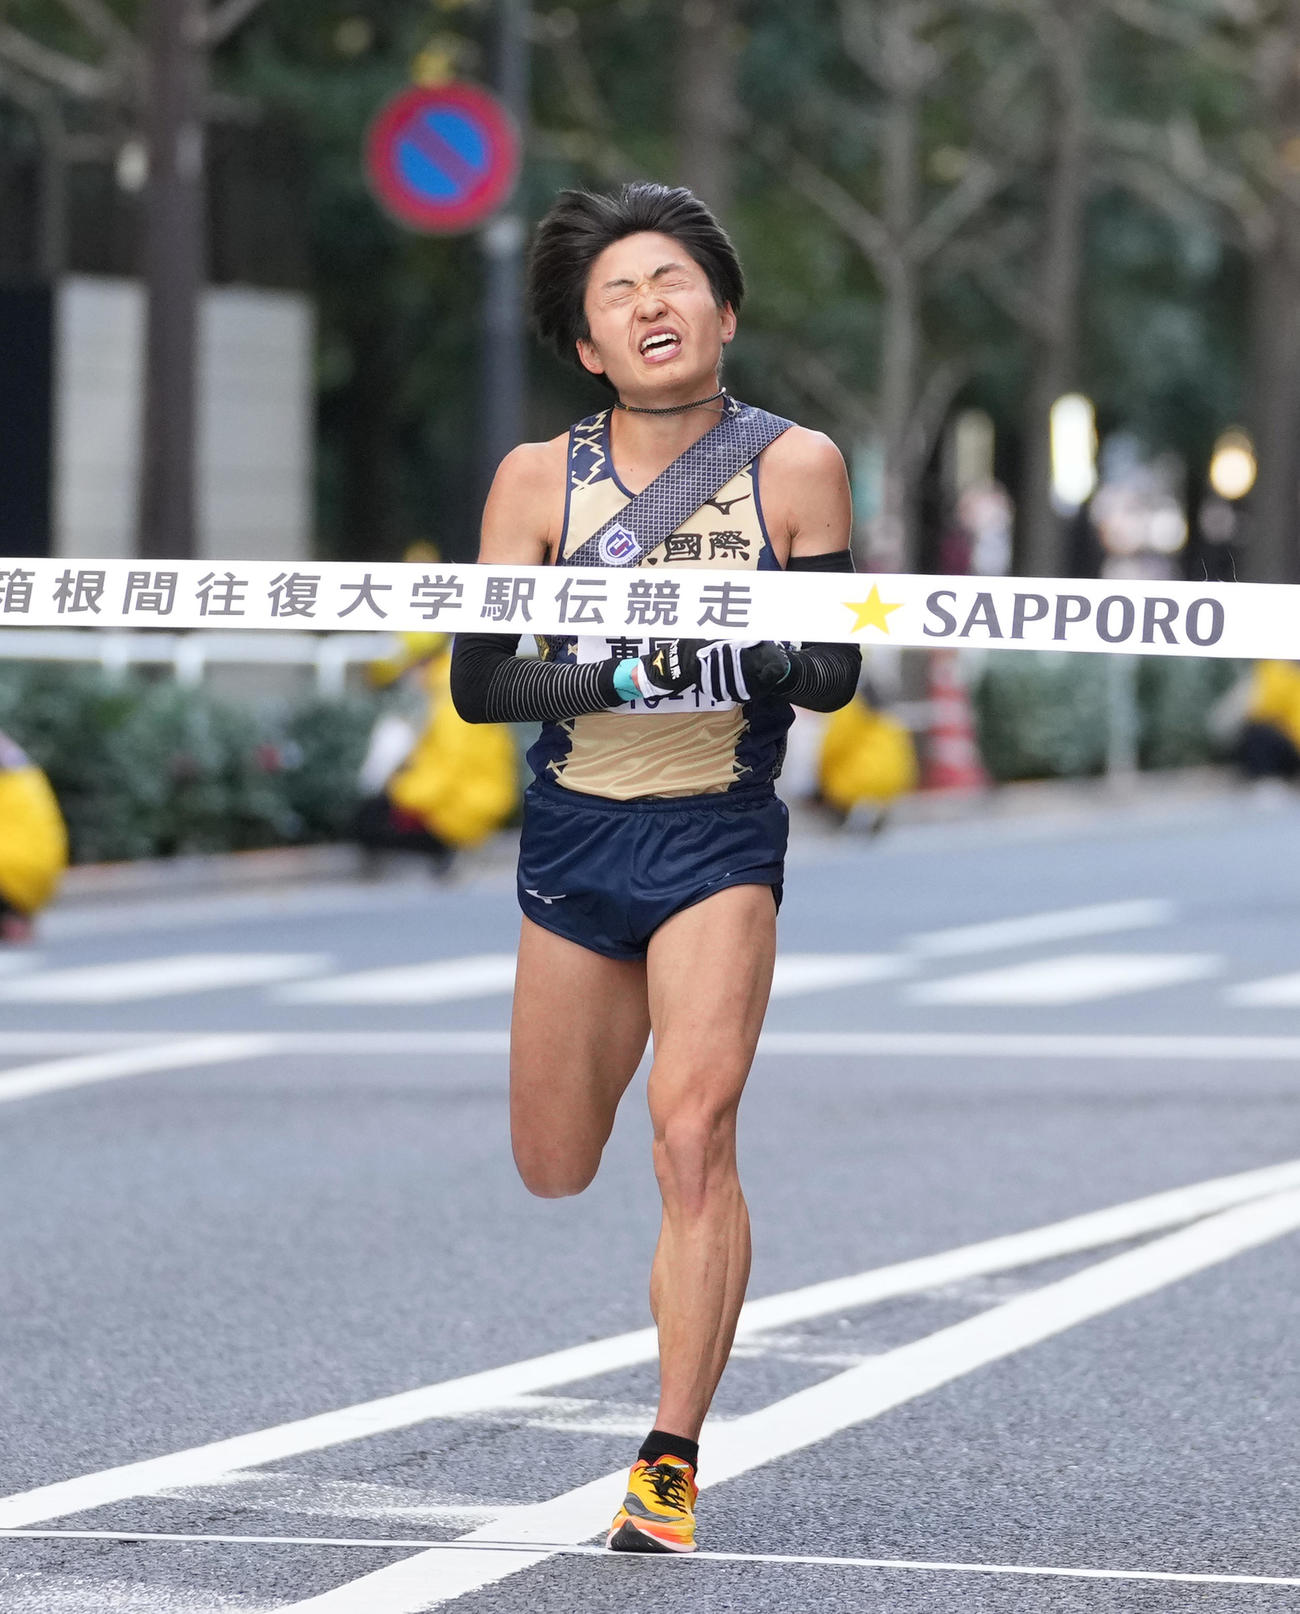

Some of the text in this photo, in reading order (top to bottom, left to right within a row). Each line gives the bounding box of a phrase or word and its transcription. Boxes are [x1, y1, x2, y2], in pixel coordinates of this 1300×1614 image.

[640, 531, 751, 564] 國際
[0, 568, 752, 627] 箱根間往復大学駅伝競走
[922, 590, 1225, 647] SAPPORO
